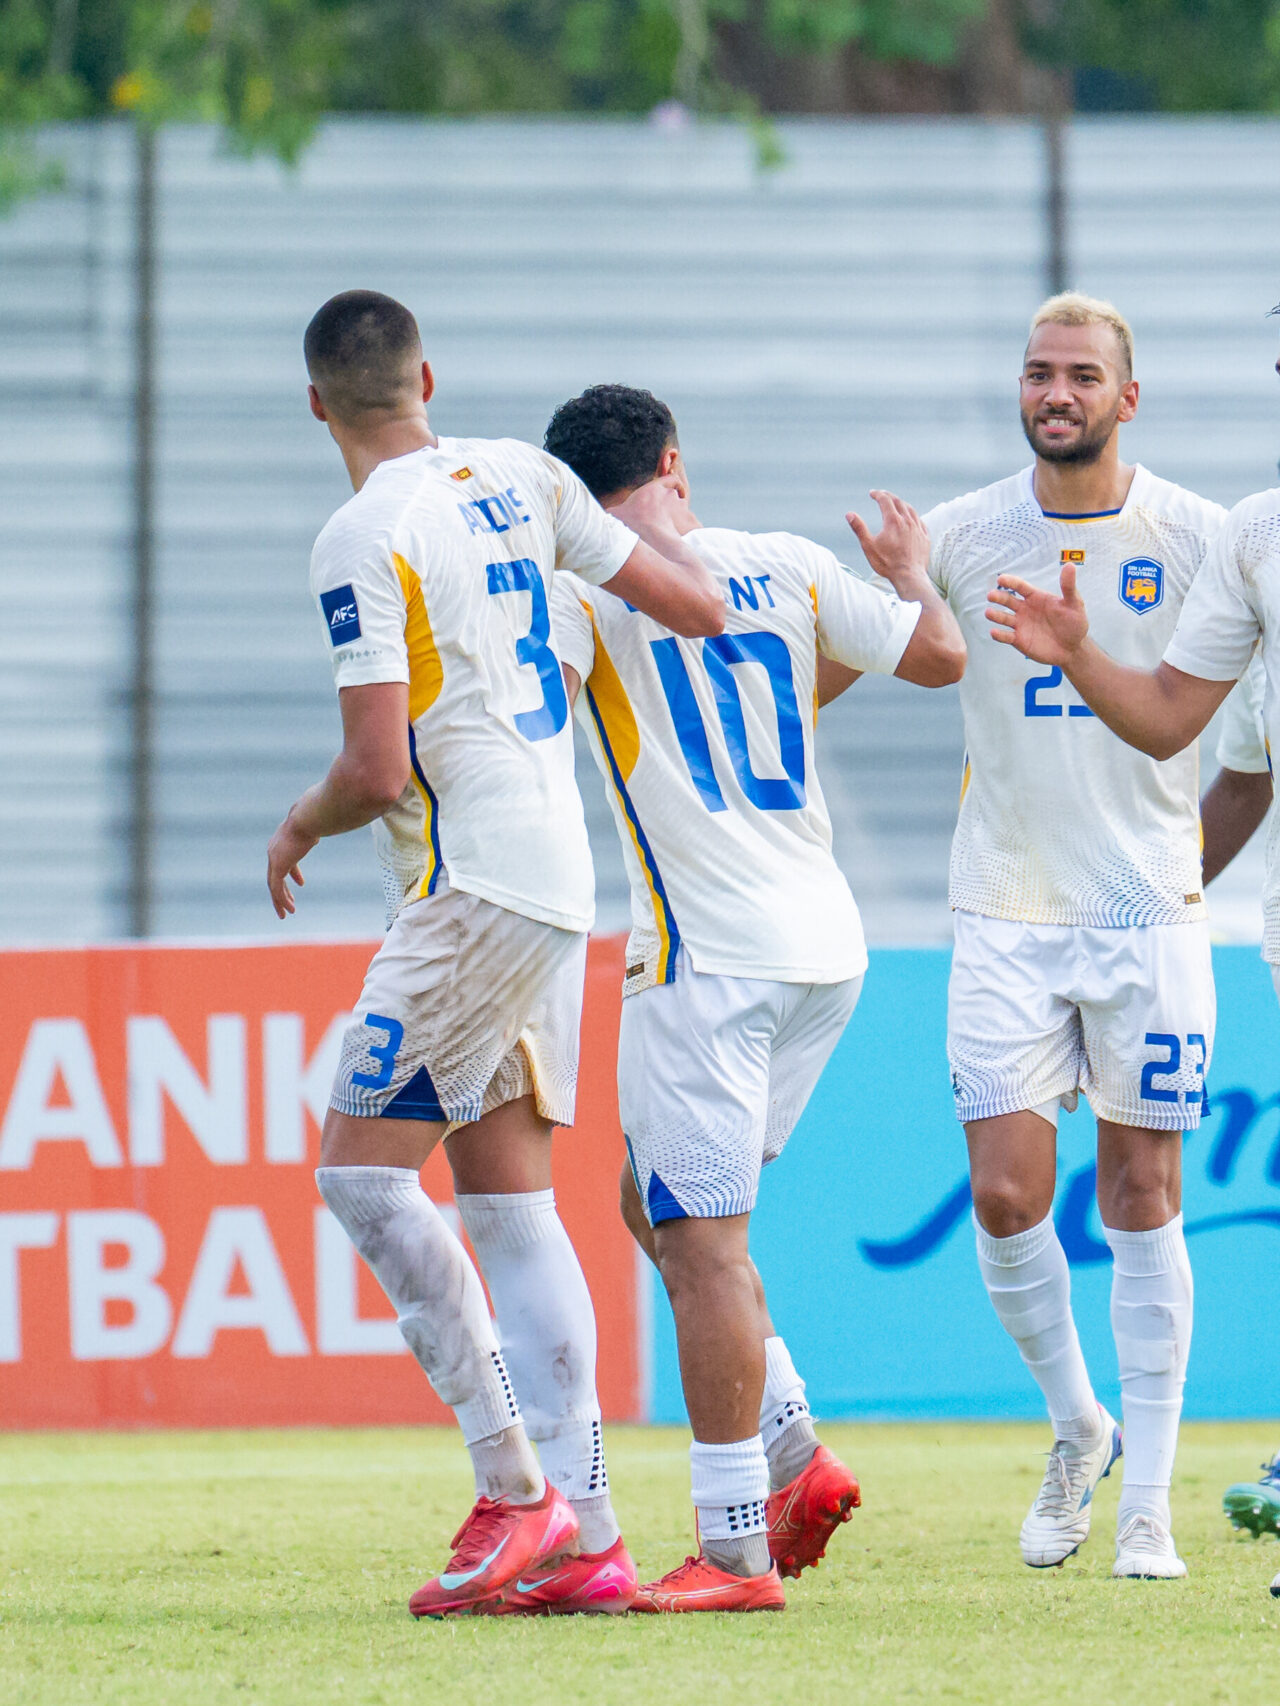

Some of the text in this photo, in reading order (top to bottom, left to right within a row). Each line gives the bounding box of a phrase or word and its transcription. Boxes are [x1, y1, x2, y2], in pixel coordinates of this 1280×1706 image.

[331, 603, 357, 626] AFC
[486, 557, 568, 742] 3
[649, 631, 807, 813] 10
[351, 1013, 404, 1090] 3
[1140, 1032, 1206, 1103] 23
